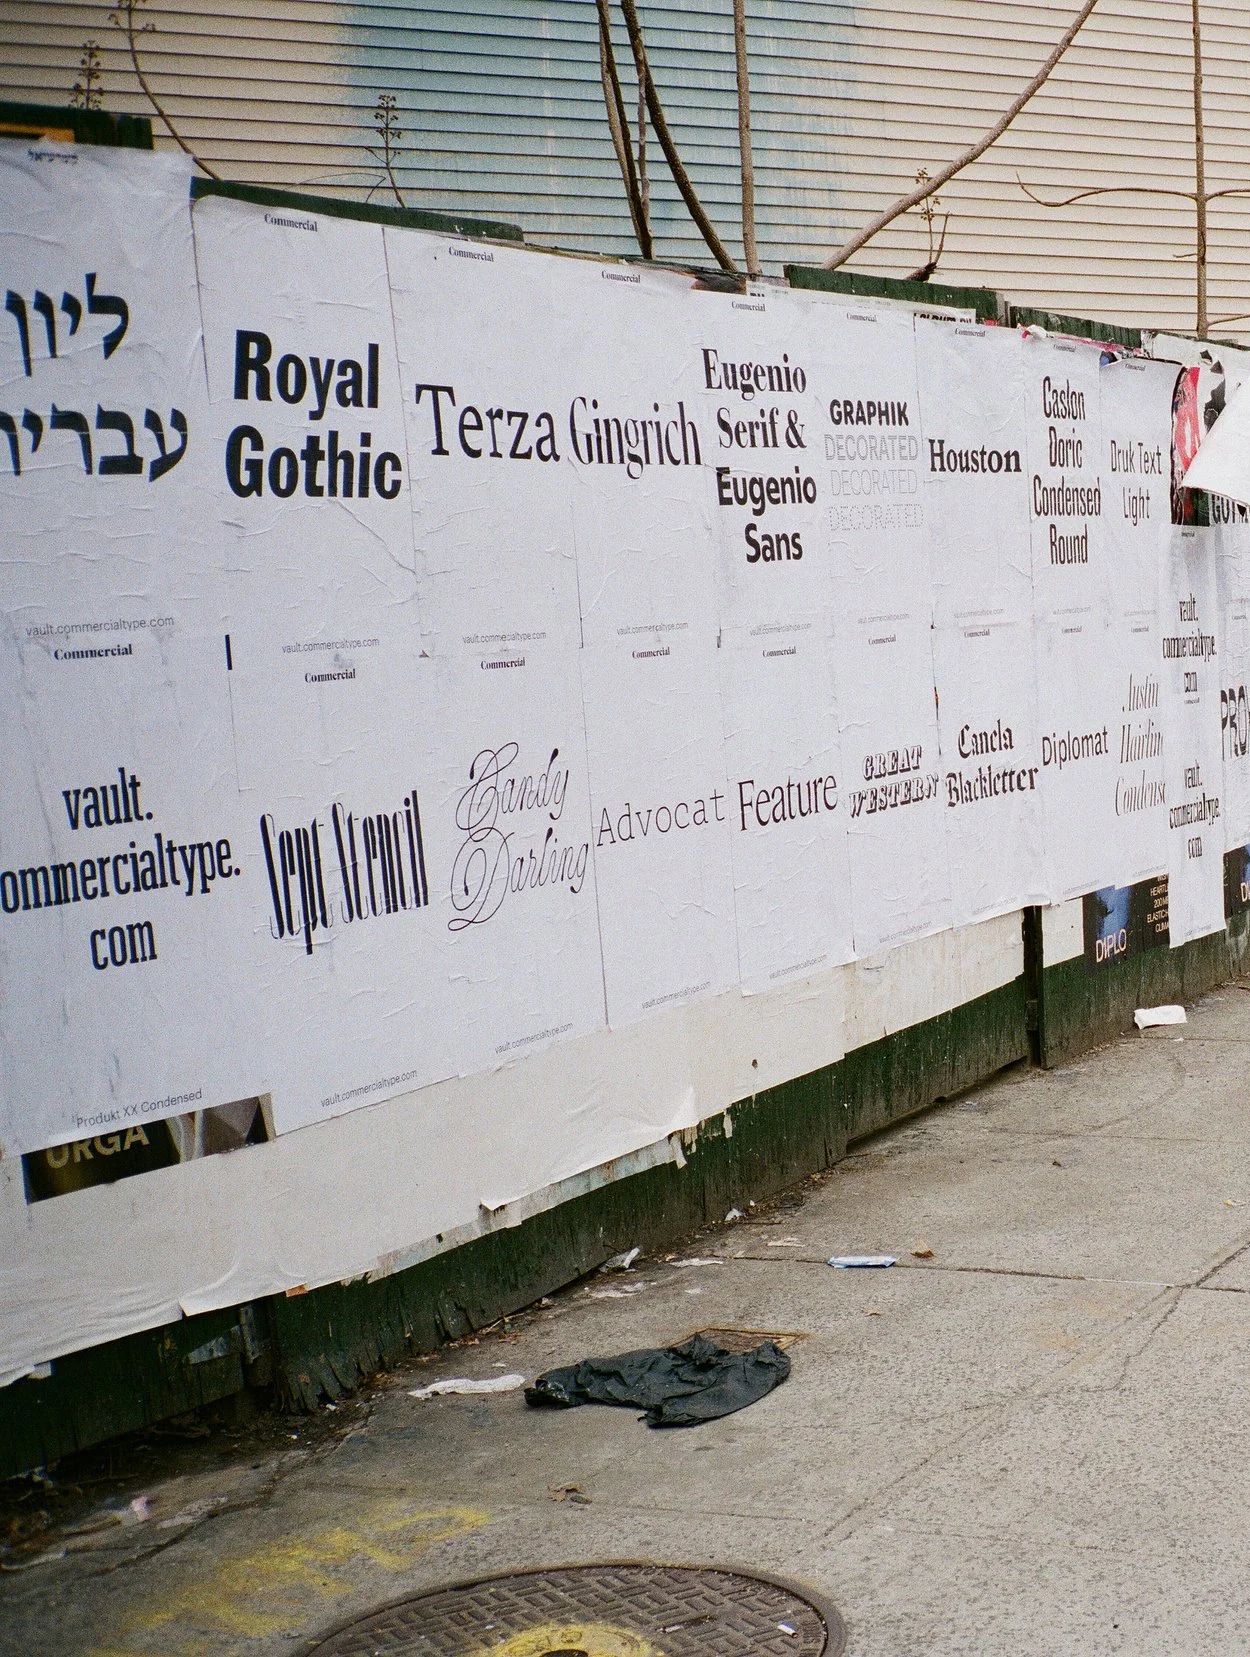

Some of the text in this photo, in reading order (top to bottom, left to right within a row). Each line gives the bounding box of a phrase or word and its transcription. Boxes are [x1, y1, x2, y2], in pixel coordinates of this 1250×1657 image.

[264, 212, 318, 233] Commercial
[448, 246, 494, 263] Commercial
[601, 270, 641, 284] Commercial
[5, 272, 130, 378] ליון
[731, 301, 766, 313] Commercial
[233, 329, 380, 422] Royal
[701, 348, 807, 401] Eugenio
[829, 398, 910, 427] GRAPHIK
[1042, 375, 1086, 421] Caslon
[415, 383, 561, 463] Terza
[569, 396, 702, 480] Gingrich
[717, 406, 808, 450] Serif &
[225, 424, 402, 501] Gothic
[824, 433, 919, 461] DECORATED
[928, 438, 1023, 474] Houston
[1049, 426, 1083, 469] Doric
[1110, 439, 1163, 475] Druk Text
[716, 465, 817, 517] Eugenio
[830, 468, 919, 496] DECORATED
[1032, 474, 1101, 518] Condensed
[828, 503, 924, 532] DECORATED
[1122, 486, 1151, 527] Light
[744, 522, 804, 564] Sans
[1049, 523, 1089, 566] Round
[26, 615, 175, 637] vault.commercialtype.com
[1178, 592, 1200, 622] vault.
[53, 643, 133, 661] Commercial
[282, 637, 380, 654] vault.commercialtype.com
[480, 656, 526, 671] Commercial
[632, 645, 671, 659] Commercial
[762, 645, 797, 658] Commercial
[1162, 628, 1218, 663] commercialtype.
[304, 668, 357, 684] Commercial
[1042, 725, 1109, 770] Diplomat
[1120, 719, 1164, 764] Hairlin
[862, 745, 922, 782] GREAT
[61, 767, 154, 831] vault.
[456, 741, 570, 843] Candy
[737, 773, 838, 832] Feature
[848, 773, 940, 818] WESTERN
[945, 764, 1039, 808] Blackletter
[596, 788, 725, 847] Advocat
[0, 832, 242, 914] ommercialtype.
[447, 827, 590, 932] Darling
[90, 918, 158, 971] com
[1095, 928, 1128, 963] DIPLO
[641, 981, 711, 1009] vault.commercialtype.com
[495, 1022, 573, 1054] vault.commercialtype.com
[76, 1088, 203, 1129] Produkt XX Condensed
[321, 1068, 418, 1108] vault.commercialtype.com
